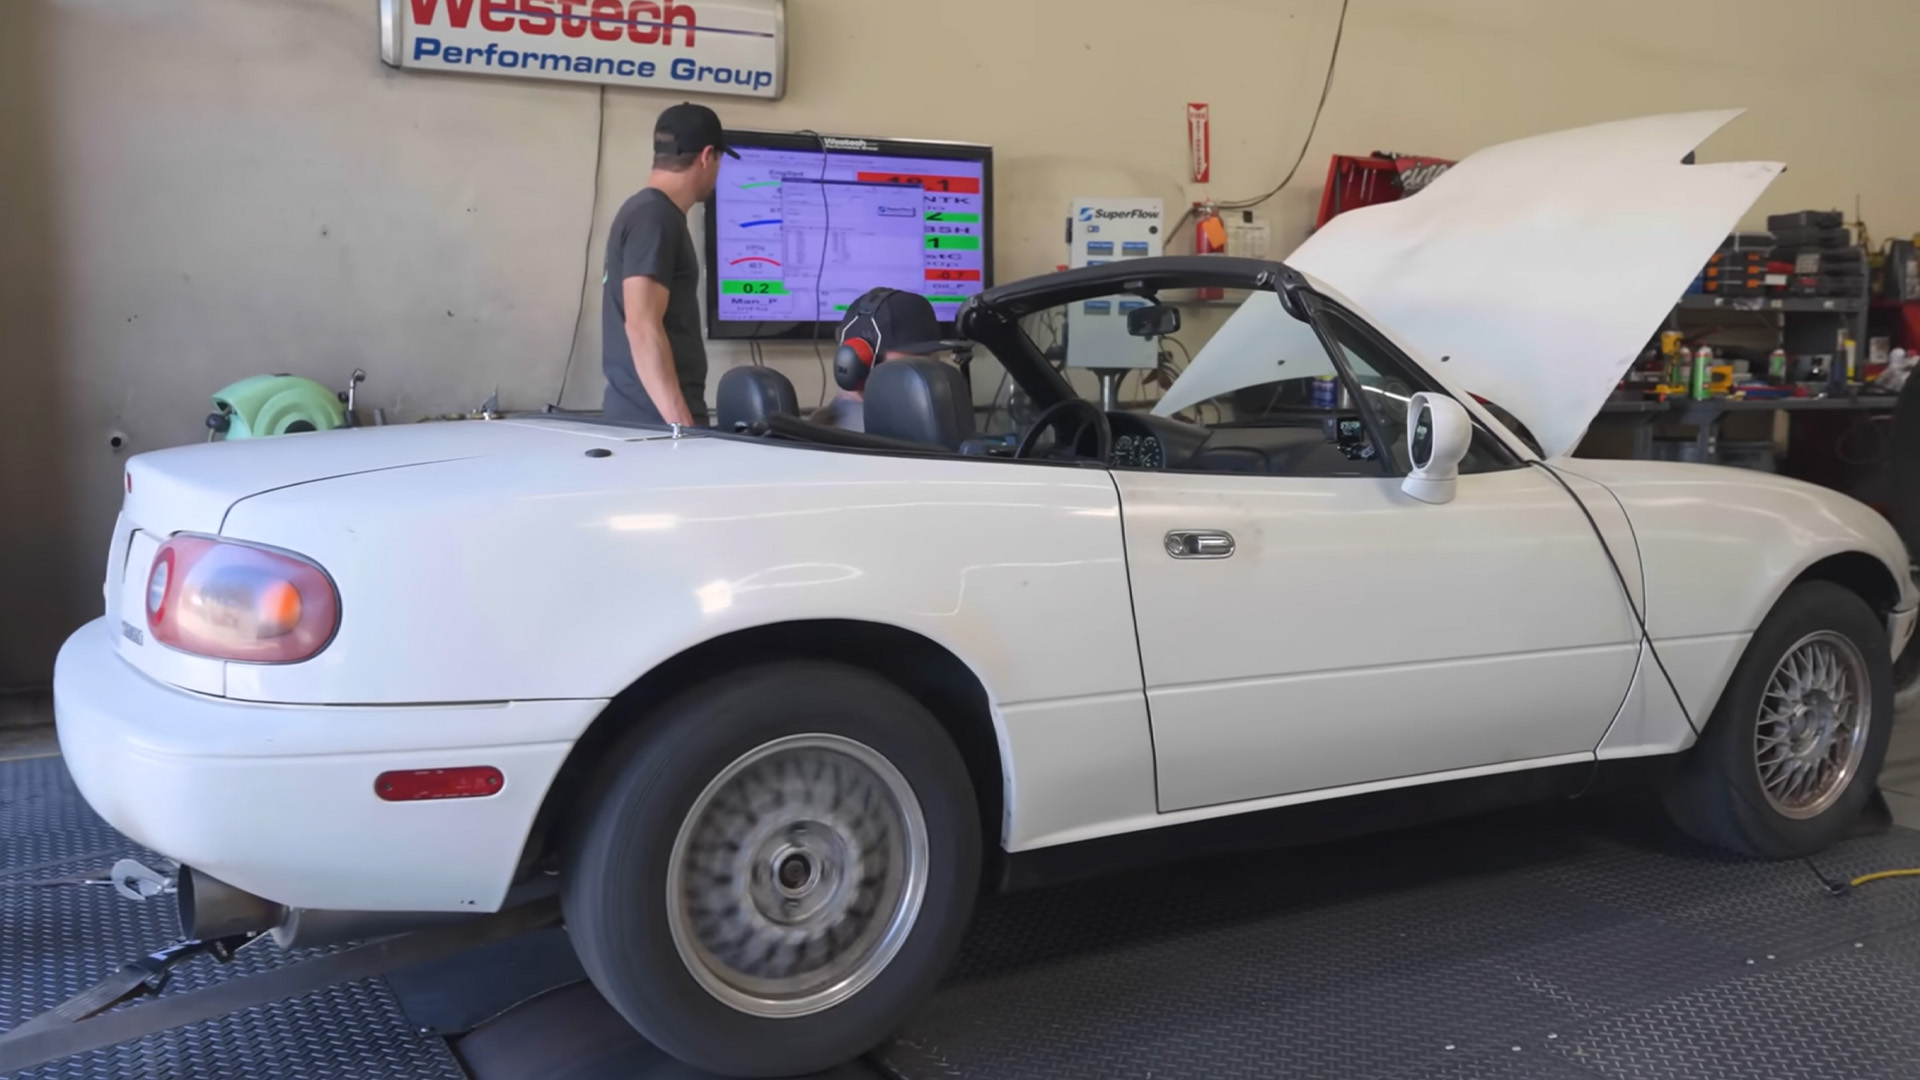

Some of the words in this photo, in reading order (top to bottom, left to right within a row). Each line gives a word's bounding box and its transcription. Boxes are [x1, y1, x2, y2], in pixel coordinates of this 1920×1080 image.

[413, 37, 656, 78] Performance
[670, 57, 773, 91] Group
[1094, 208, 1159, 220] SuperFlow
[742, 282, 769, 294] 0.2
